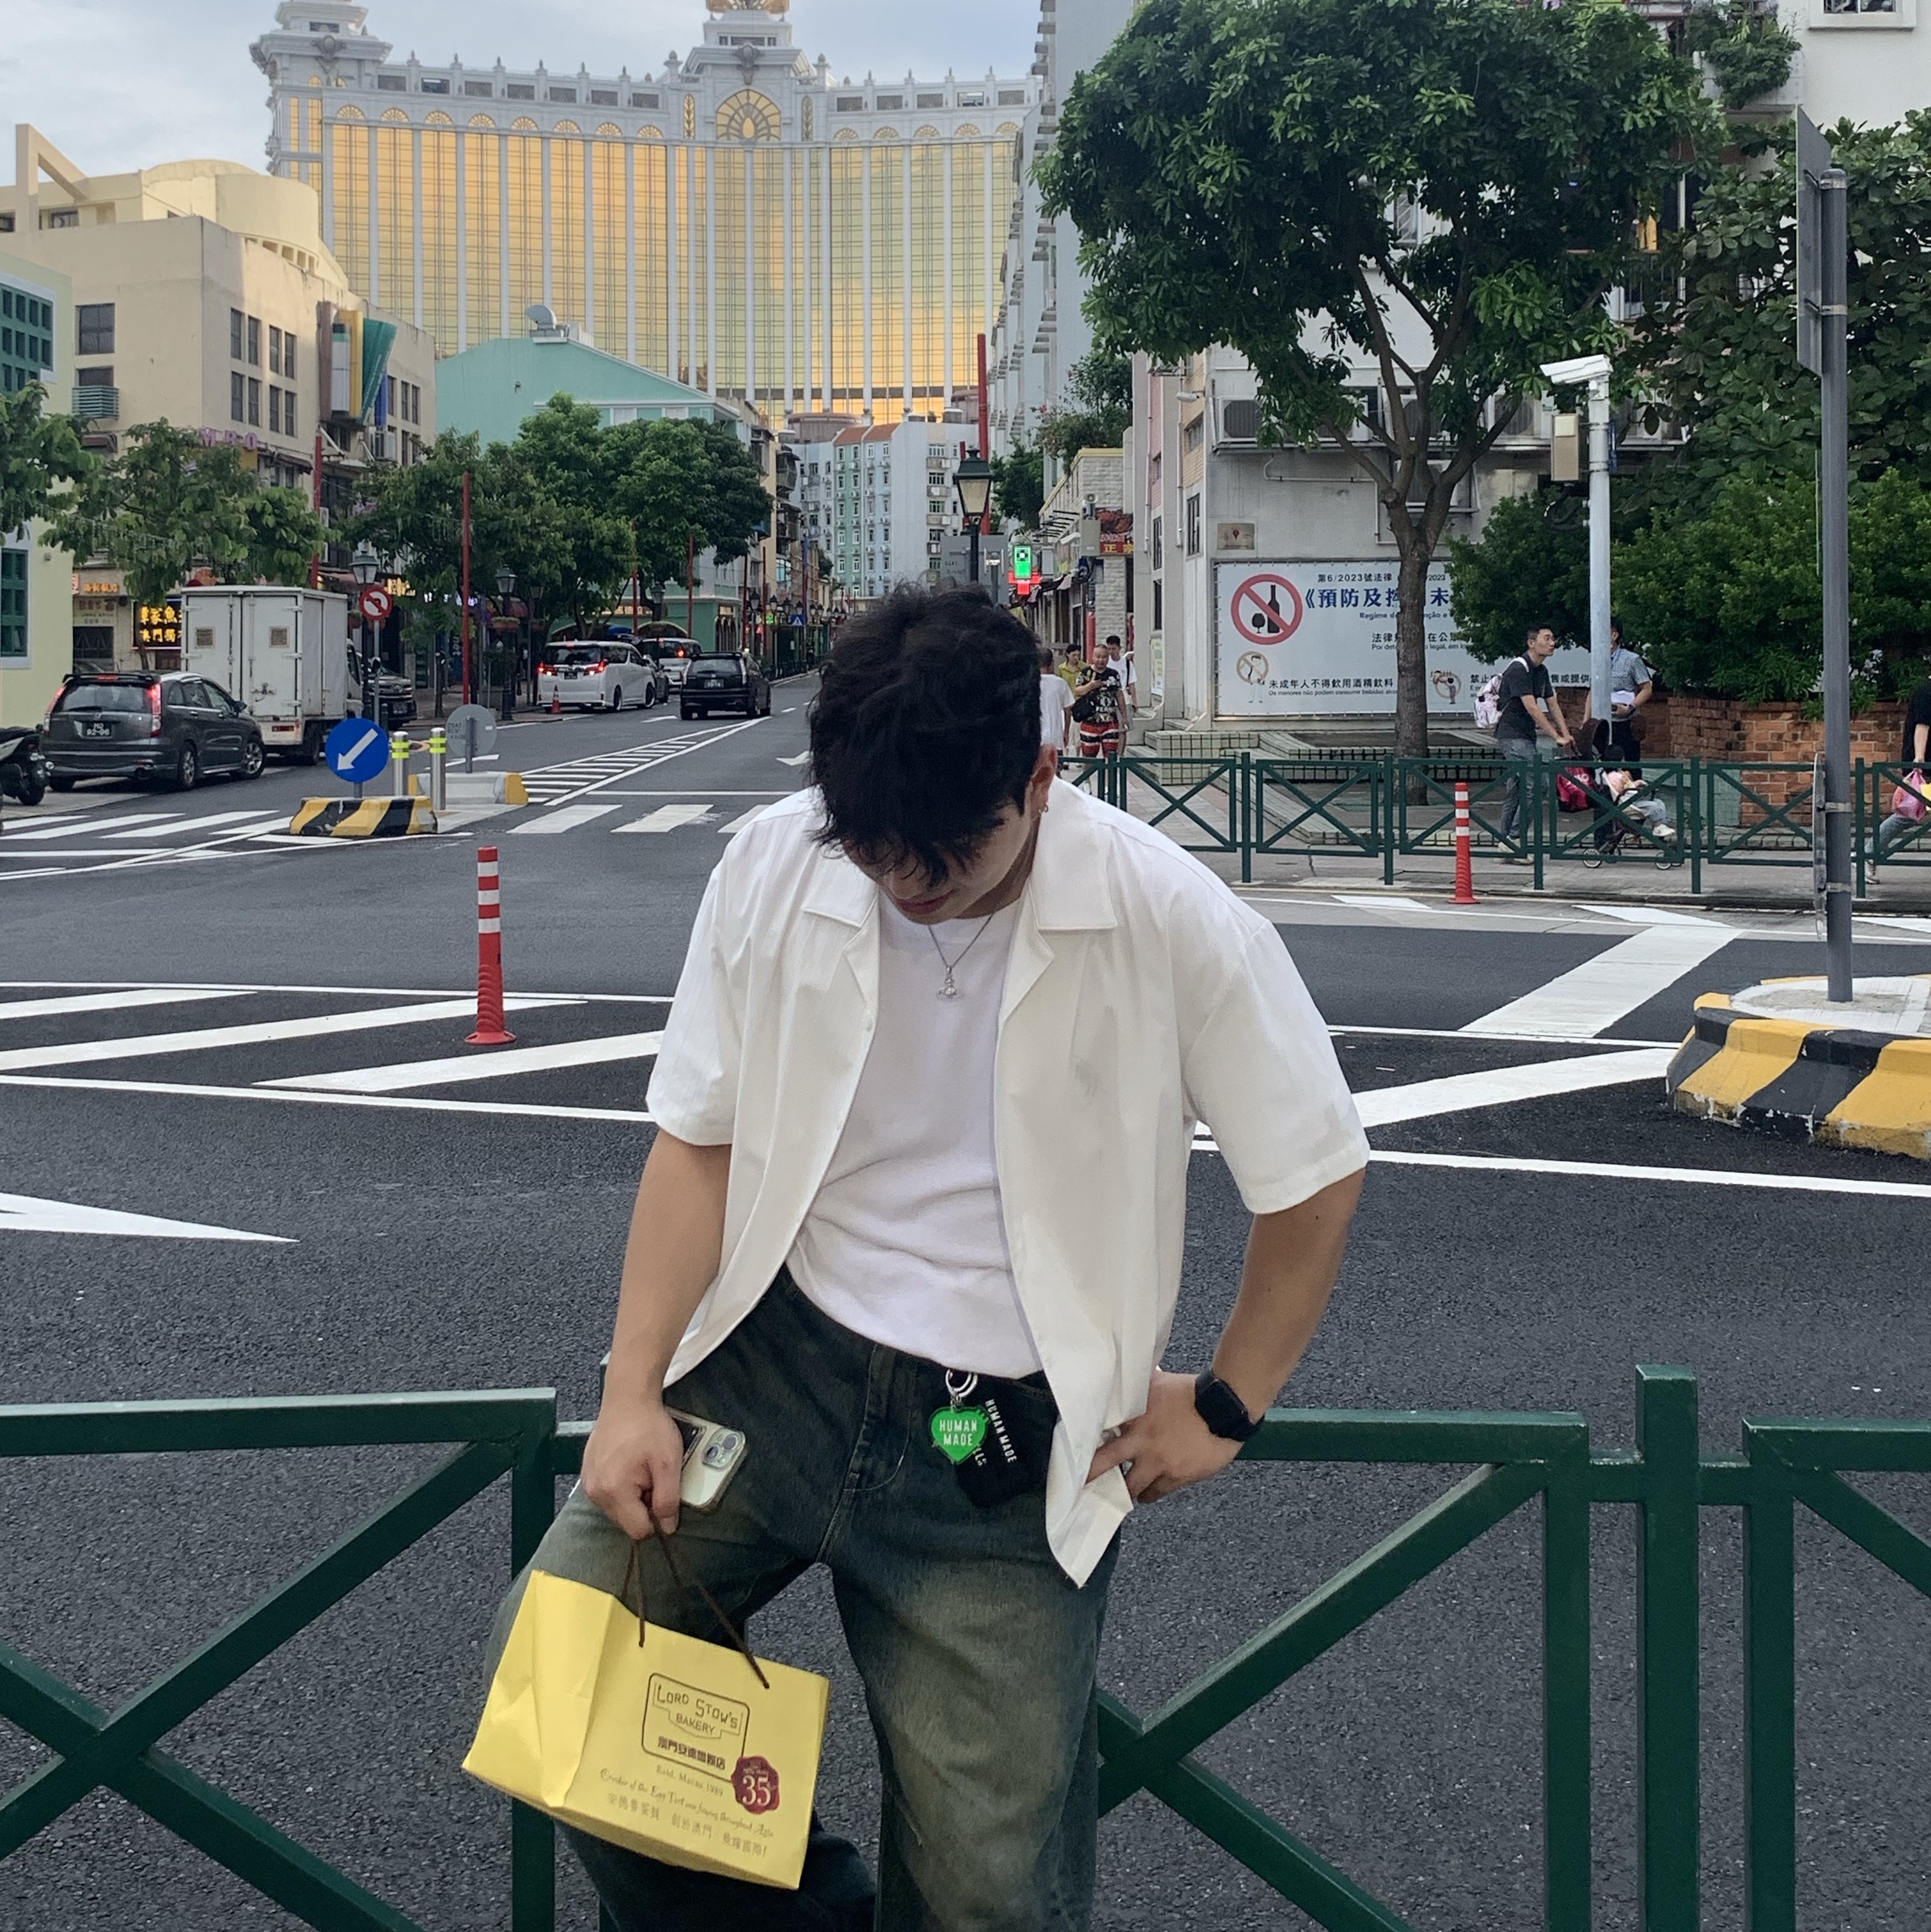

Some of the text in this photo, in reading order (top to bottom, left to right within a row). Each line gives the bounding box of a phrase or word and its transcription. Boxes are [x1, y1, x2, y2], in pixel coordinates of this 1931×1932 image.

[1359, 612, 1387, 620] Regime
[1269, 678, 1393, 689] 未成年人不得飲用酒精飲料
[940, 1419, 977, 1432] HUMAN
[985, 1399, 1017, 1463] HUMAN MADE
[943, 1433, 973, 1446] MADE
[676, 1713, 715, 1735] BAKERY
[742, 1774, 771, 1806] 35
